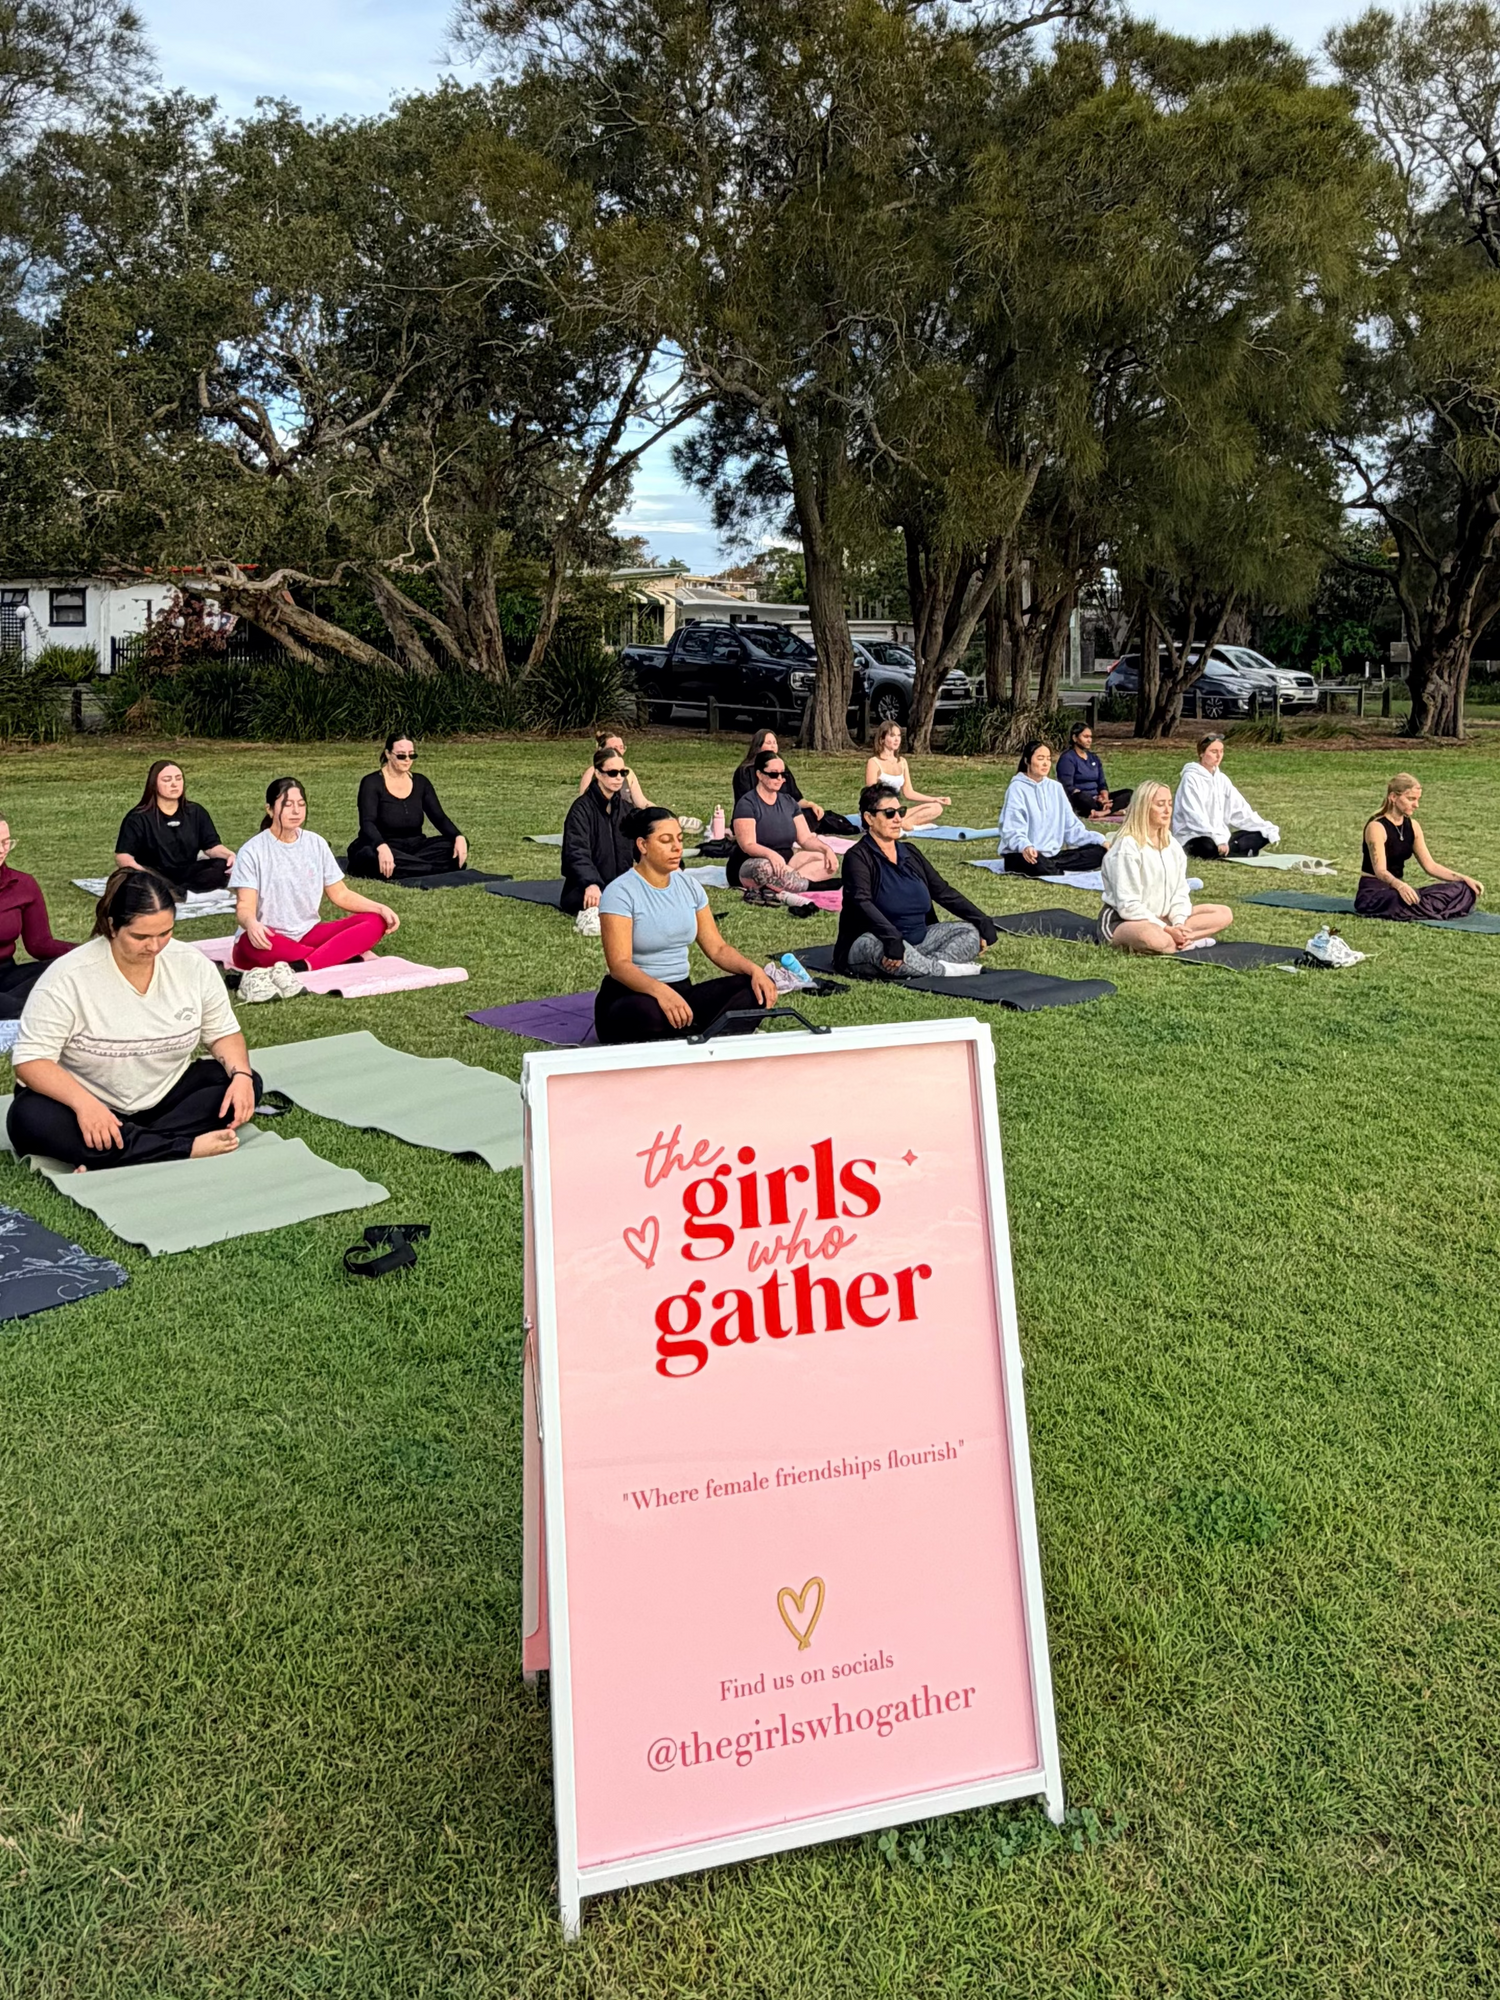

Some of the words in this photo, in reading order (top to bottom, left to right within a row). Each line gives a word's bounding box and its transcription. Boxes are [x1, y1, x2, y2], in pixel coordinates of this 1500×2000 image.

[636, 1124, 725, 1188] the
[681, 1137, 881, 1262] girls
[748, 1208, 857, 1272] who
[655, 1263, 932, 1378] gather
[622, 1487, 700, 1511] "Where
[705, 1472, 769, 1499] female
[775, 1457, 881, 1489] friendships
[887, 1439, 965, 1469] flourish"
[719, 1673, 766, 1701] Find
[772, 1673, 795, 1690] us
[800, 1668, 826, 1685] on
[831, 1649, 894, 1679] socials
[646, 1684, 976, 1772] @thegirlswhogather
